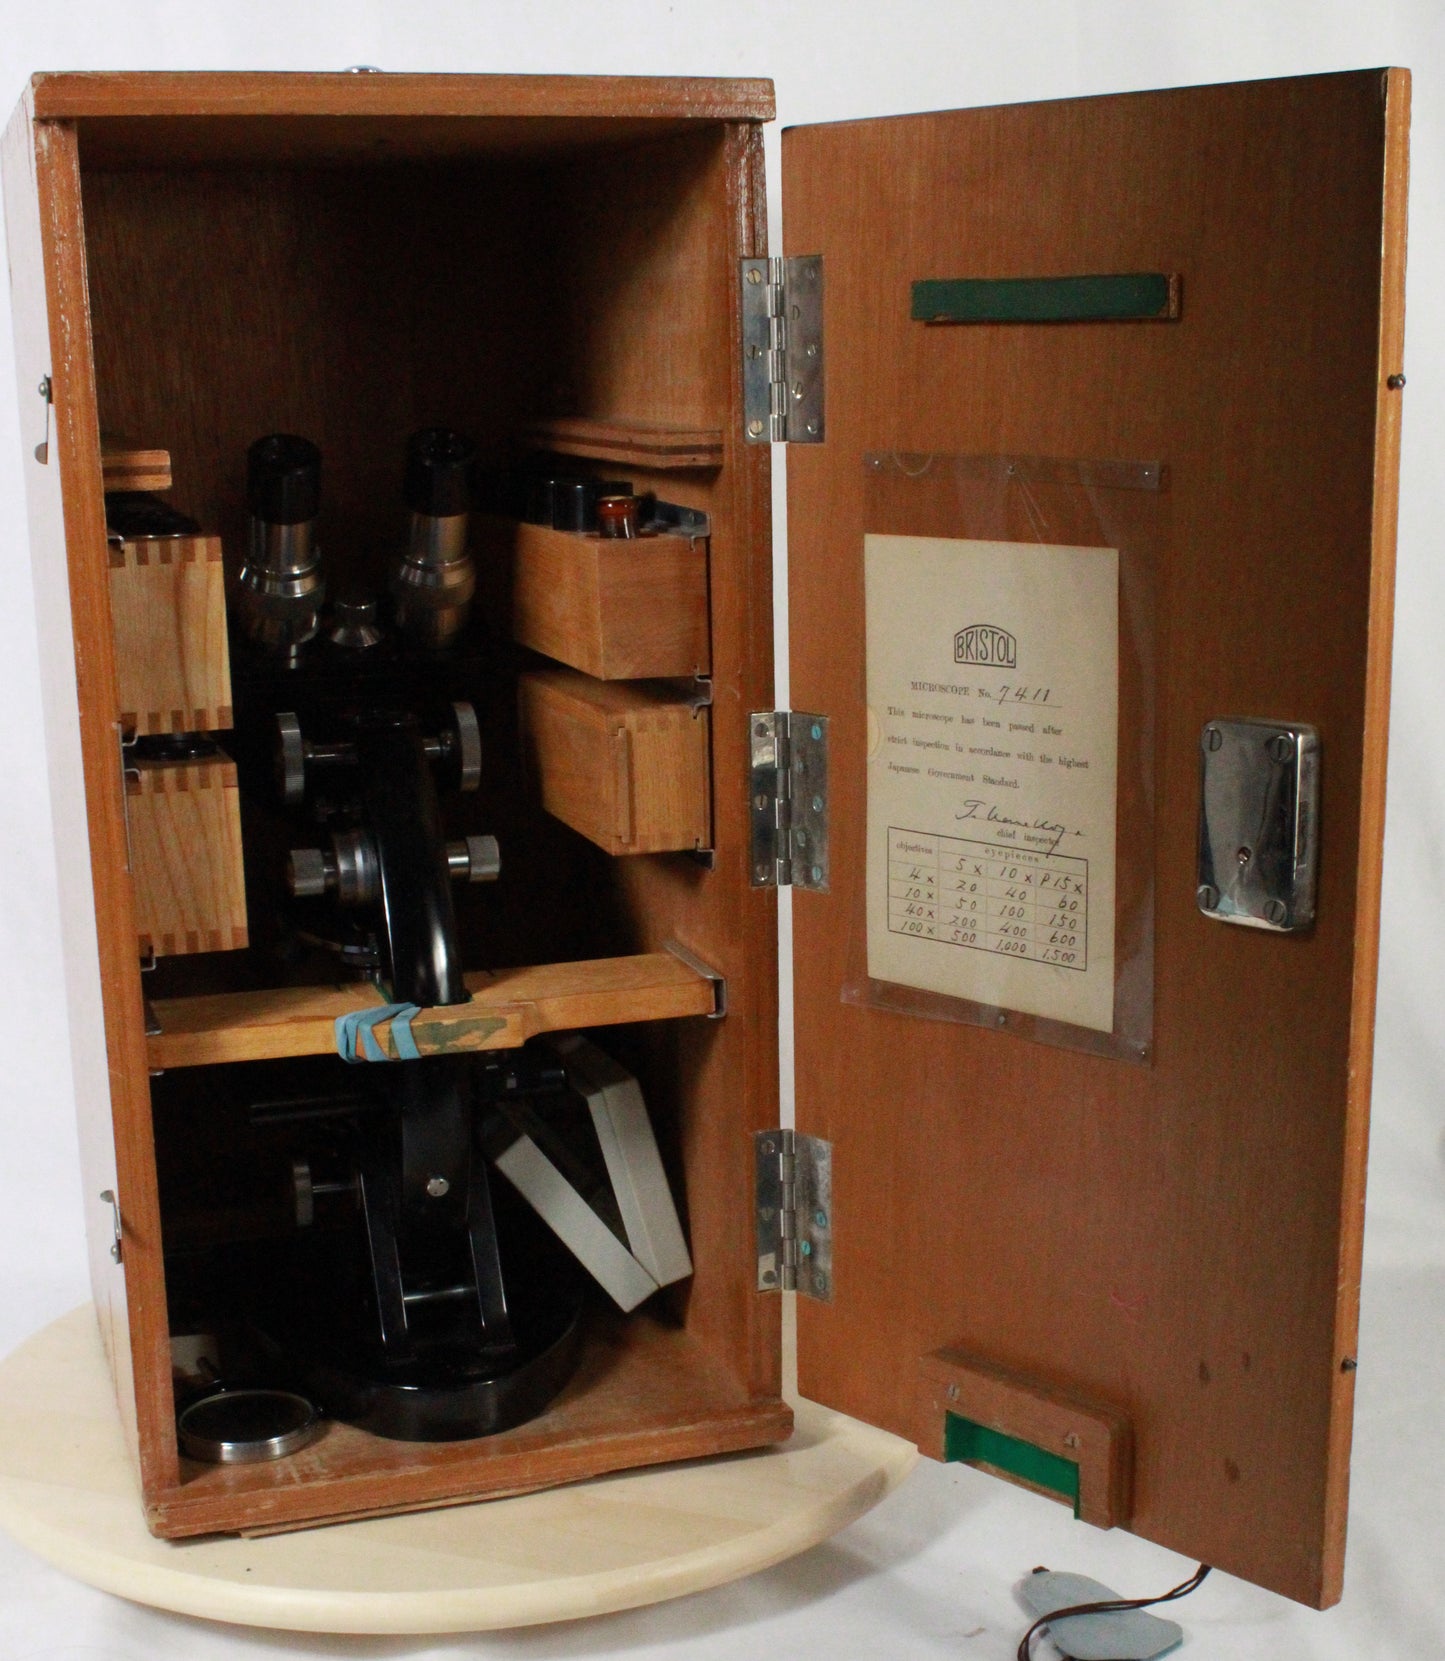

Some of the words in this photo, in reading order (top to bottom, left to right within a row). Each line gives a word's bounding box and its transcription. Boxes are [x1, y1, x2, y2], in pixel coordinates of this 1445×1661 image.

[957, 629, 1014, 664] BRISTOL
[910, 681, 969, 696] MICROSCOPE
[887, 706, 905, 717] This
[912, 711, 953, 724] microscope
[961, 714, 975, 724] has
[982, 717, 1001, 728] been
[1008, 722, 1034, 733] passed
[1042, 725, 1063, 735] after
[887, 736, 907, 745] strict
[912, 737, 950, 751] inspection
[955, 742, 963, 752] in
[968, 746, 1011, 758] accordance
[1017, 752, 1034, 761] with
[1039, 754, 1053, 764] the
[1058, 755, 1089, 769] highest
[887, 761, 920, 774] Japanese
[927, 767, 974, 782] Government
[982, 774, 1020, 789] Standard.
[996, 828, 1016, 840] chief
[896, 840, 933, 855] objectives
[984, 846, 1040, 863] eyepieces
[956, 879, 977, 892] 20
[1005, 886, 1027, 901] 40
[956, 897, 977, 910] 50
[999, 905, 1025, 918] 100
[1049, 914, 1077, 930] 150
[949, 915, 977, 929] 200
[999, 921, 1027, 937] 400
[951, 929, 977, 943] 500
